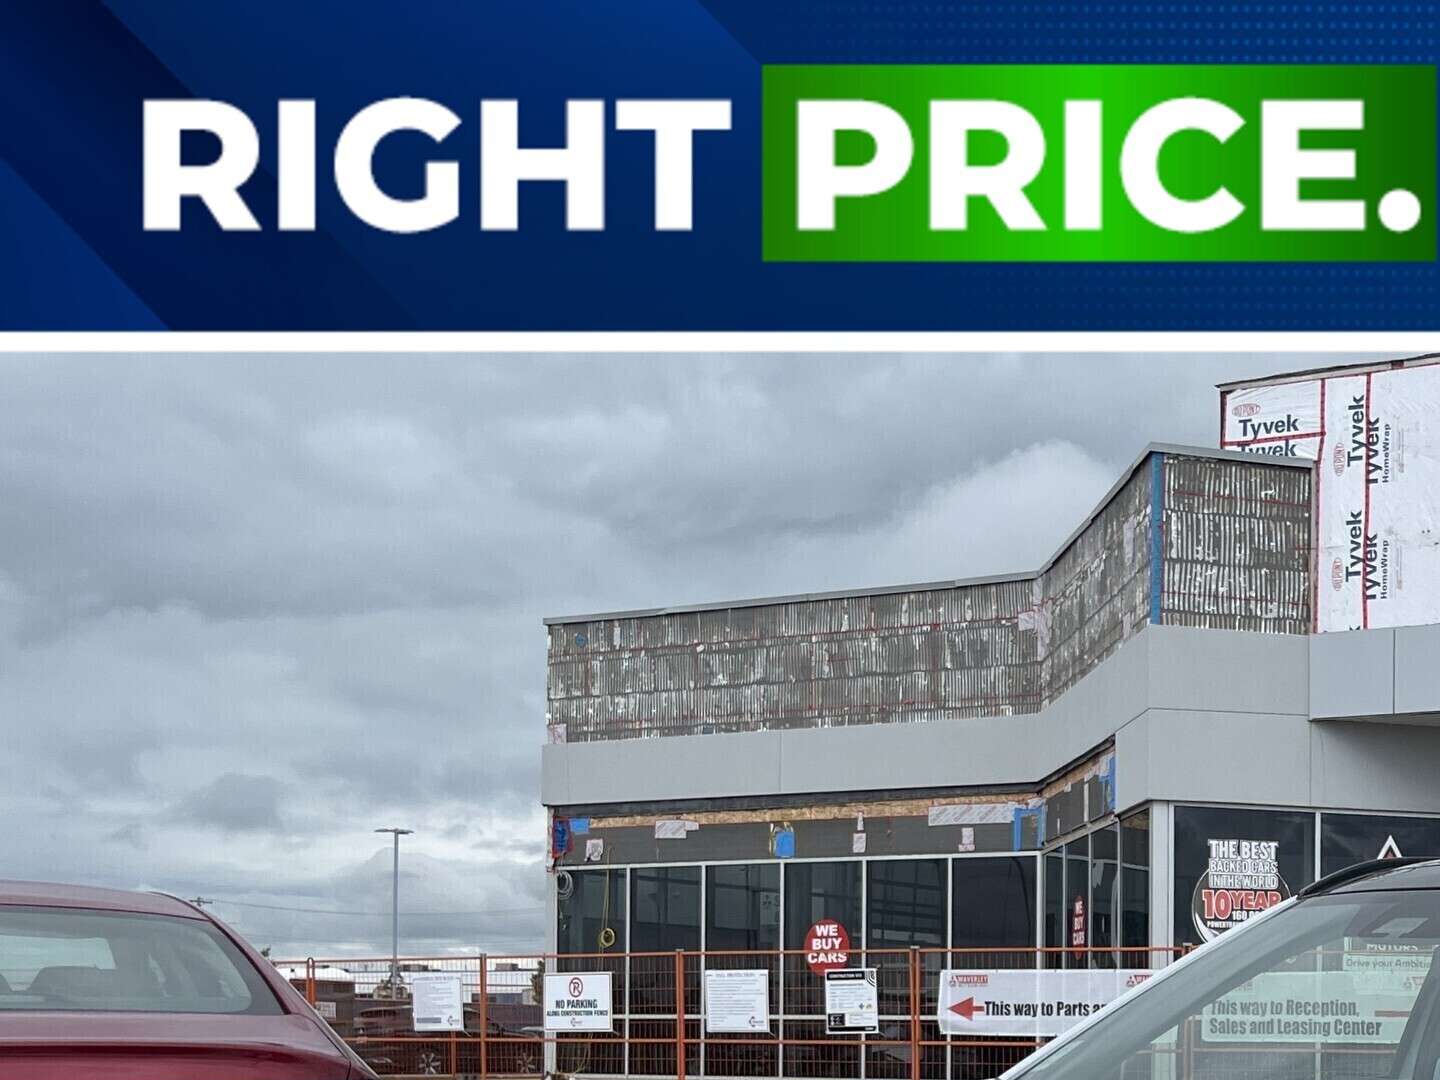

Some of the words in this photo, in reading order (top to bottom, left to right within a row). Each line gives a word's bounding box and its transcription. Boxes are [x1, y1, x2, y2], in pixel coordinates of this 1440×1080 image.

[1239, 414, 1300, 440] Tyvek
[1347, 394, 1366, 468] Tyvek
[1382, 424, 1392, 483] HomeWrap
[1345, 509, 1366, 582] Tyvek
[1381, 540, 1389, 599] HomeWrap
[1208, 839, 1238, 859] THE
[1239, 841, 1279, 860] BEST
[1209, 859, 1249, 873] BACKED
[1250, 861, 1278, 874] CARS
[1220, 875, 1241, 888] THE
[1241, 875, 1279, 889] WORLD
[1202, 889, 1232, 920] 10
[815, 924, 838, 937] WE
[812, 938, 842, 950] BUY
[808, 952, 847, 963] CARS
[556, 999, 565, 1009] NO
[567, 999, 597, 1008] PARKING
[984, 1001, 1010, 1016] This
[1013, 1003, 1038, 1018] way
[1041, 1001, 1053, 1016] to
[1057, 1001, 1089, 1016] Parts
[1210, 1000, 1239, 1015] This
[1240, 1002, 1266, 1017] way
[1270, 1001, 1281, 1016] to
[1286, 1000, 1360, 1018] Reception,
[1209, 1018, 1246, 1034] Sales
[1249, 1019, 1273, 1034] and
[1277, 1019, 1331, 1036] Leasing
[1334, 1020, 1382, 1036] Center
